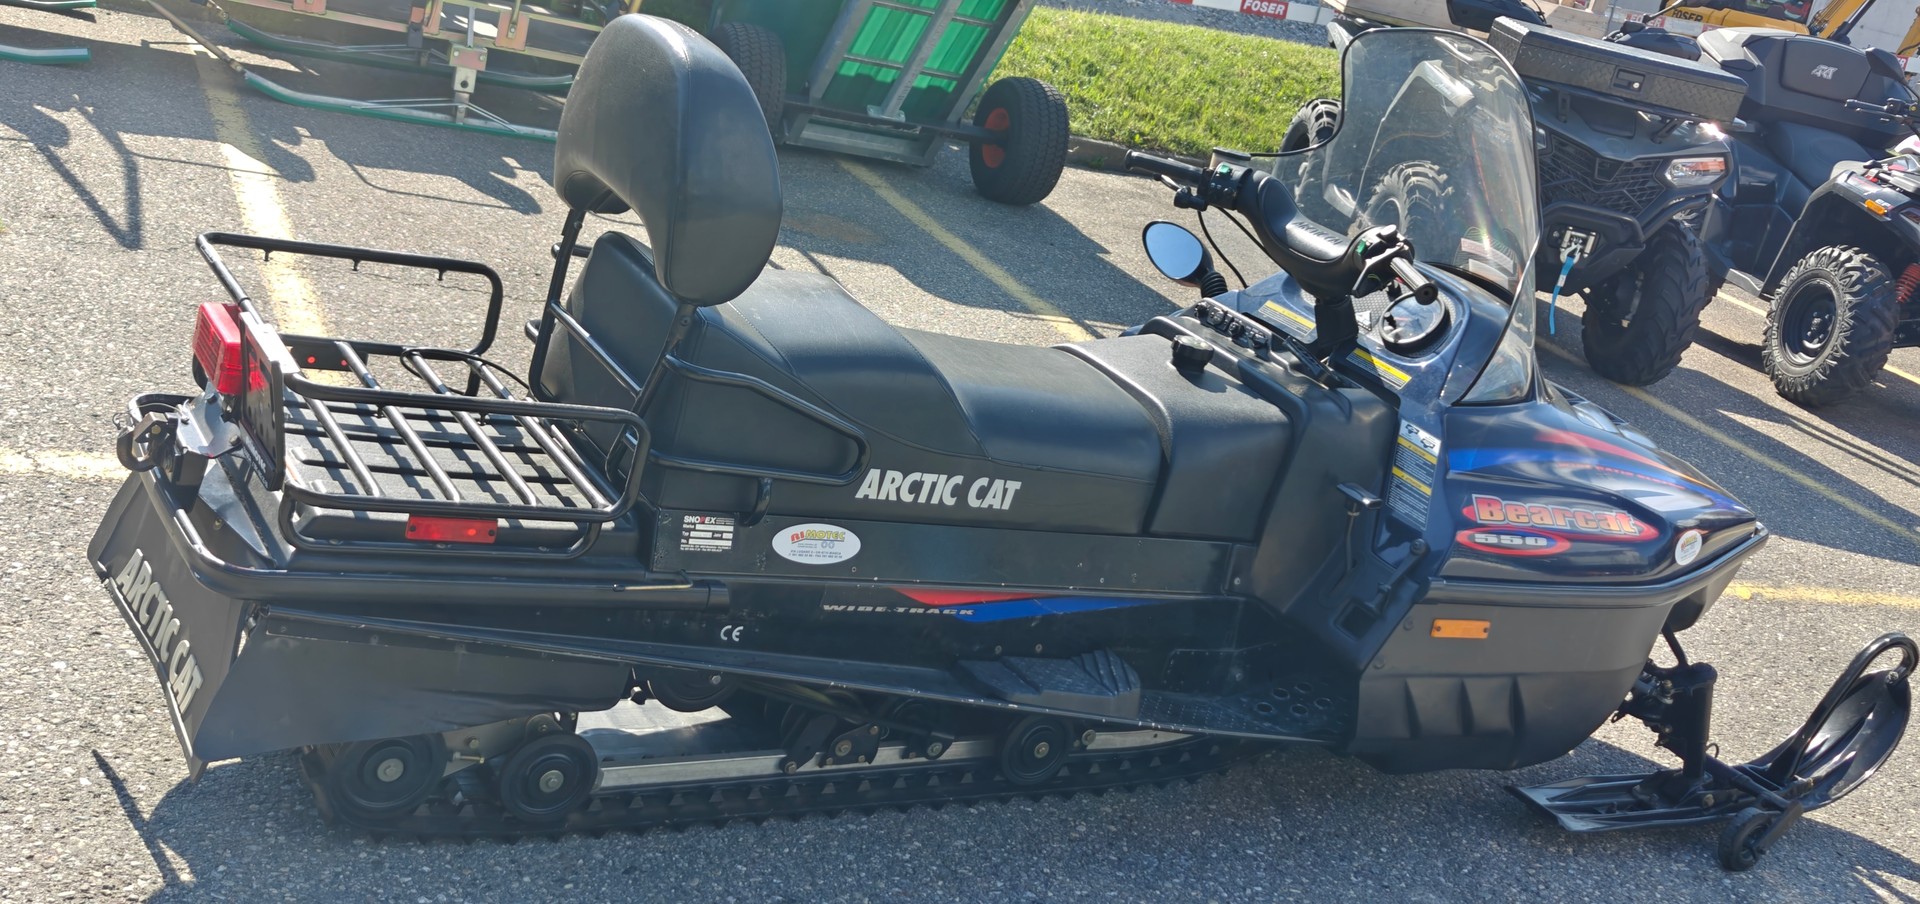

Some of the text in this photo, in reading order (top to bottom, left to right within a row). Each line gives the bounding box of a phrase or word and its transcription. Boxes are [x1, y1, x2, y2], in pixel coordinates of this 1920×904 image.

[1243, 0, 1286, 16] FOSER
[1631, 13, 1662, 28] FOER
[1771, 322, 1783, 362] ARISUN
[855, 468, 1022, 510] ARCTIC CAT
[1472, 494, 1640, 536] Bearcat
[1474, 533, 1548, 546] 550
[893, 606, 975, 616] TRACK
[116, 548, 204, 715] ARCTIC CAT
[720, 624, 744, 642] CE
